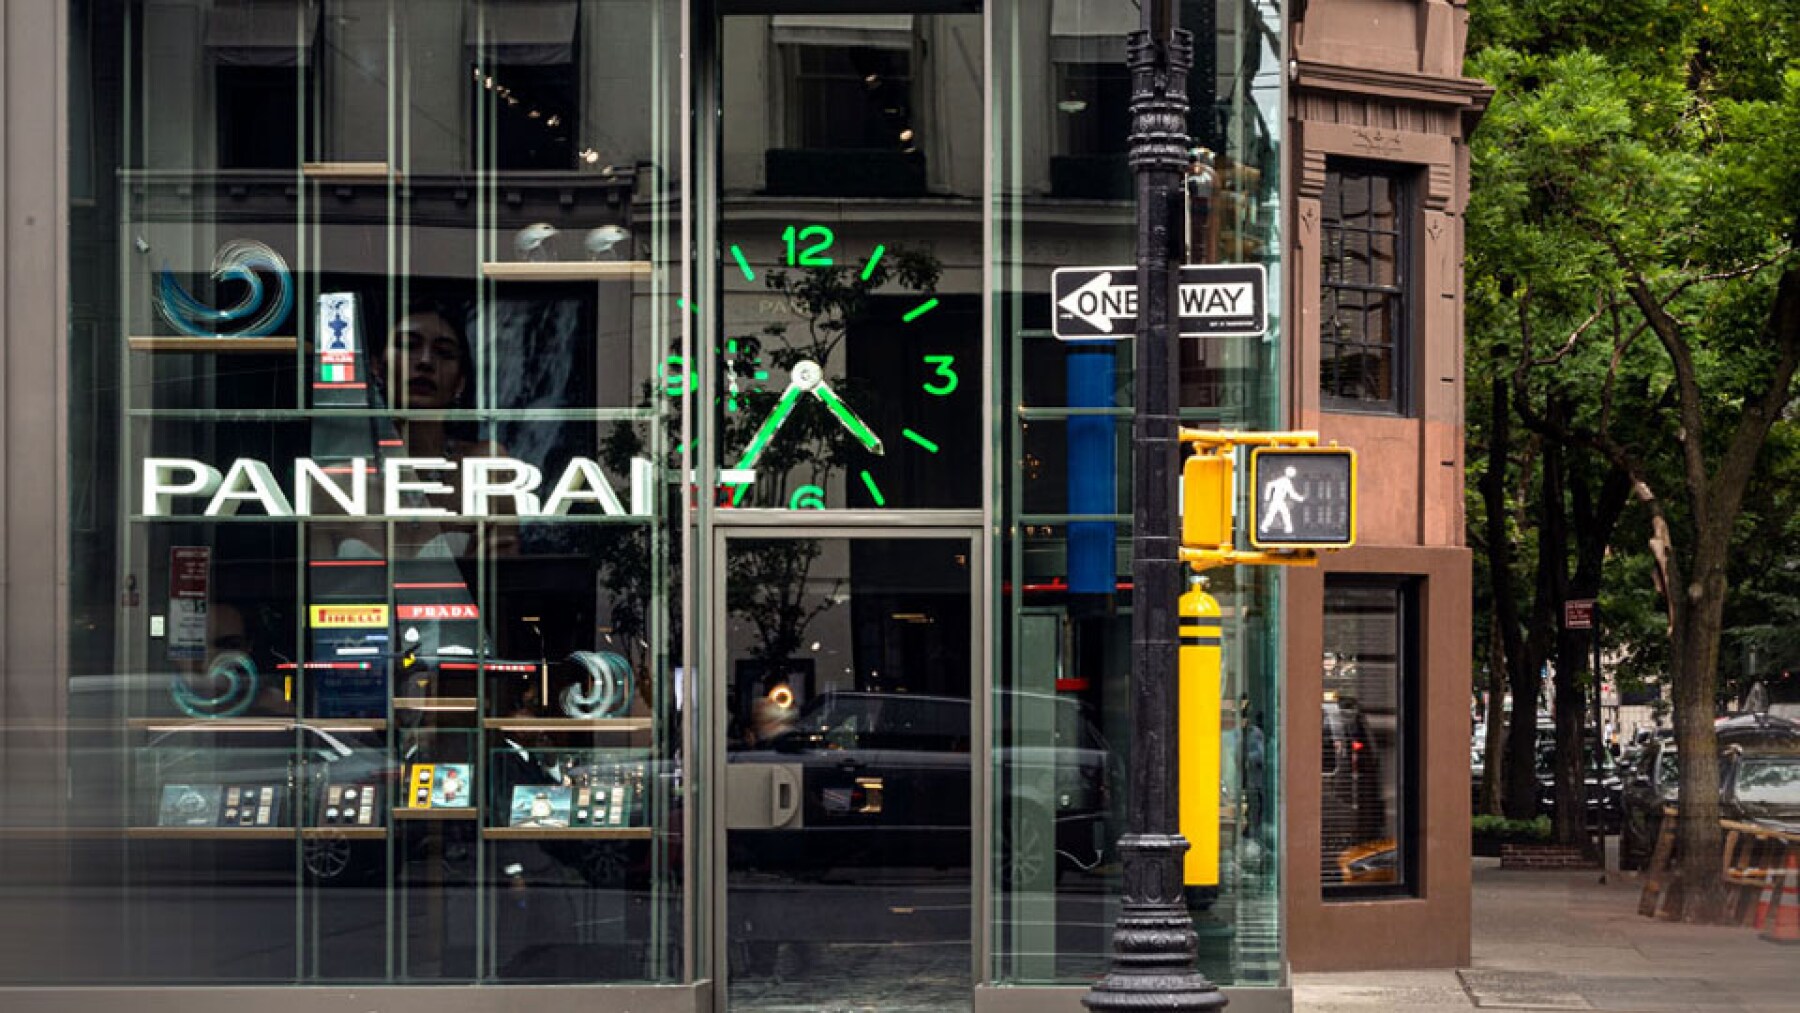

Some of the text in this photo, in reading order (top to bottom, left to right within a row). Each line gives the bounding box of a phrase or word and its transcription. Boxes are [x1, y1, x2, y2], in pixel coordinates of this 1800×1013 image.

[782, 226, 835, 266] 12
[1077, 287, 1245, 316] ONE WAY
[923, 355, 958, 395] 3
[142, 456, 652, 517] PANERAI
[789, 483, 825, 510] 6
[318, 607, 382, 623] PIRELLI
[412, 606, 475, 617] PRADA
